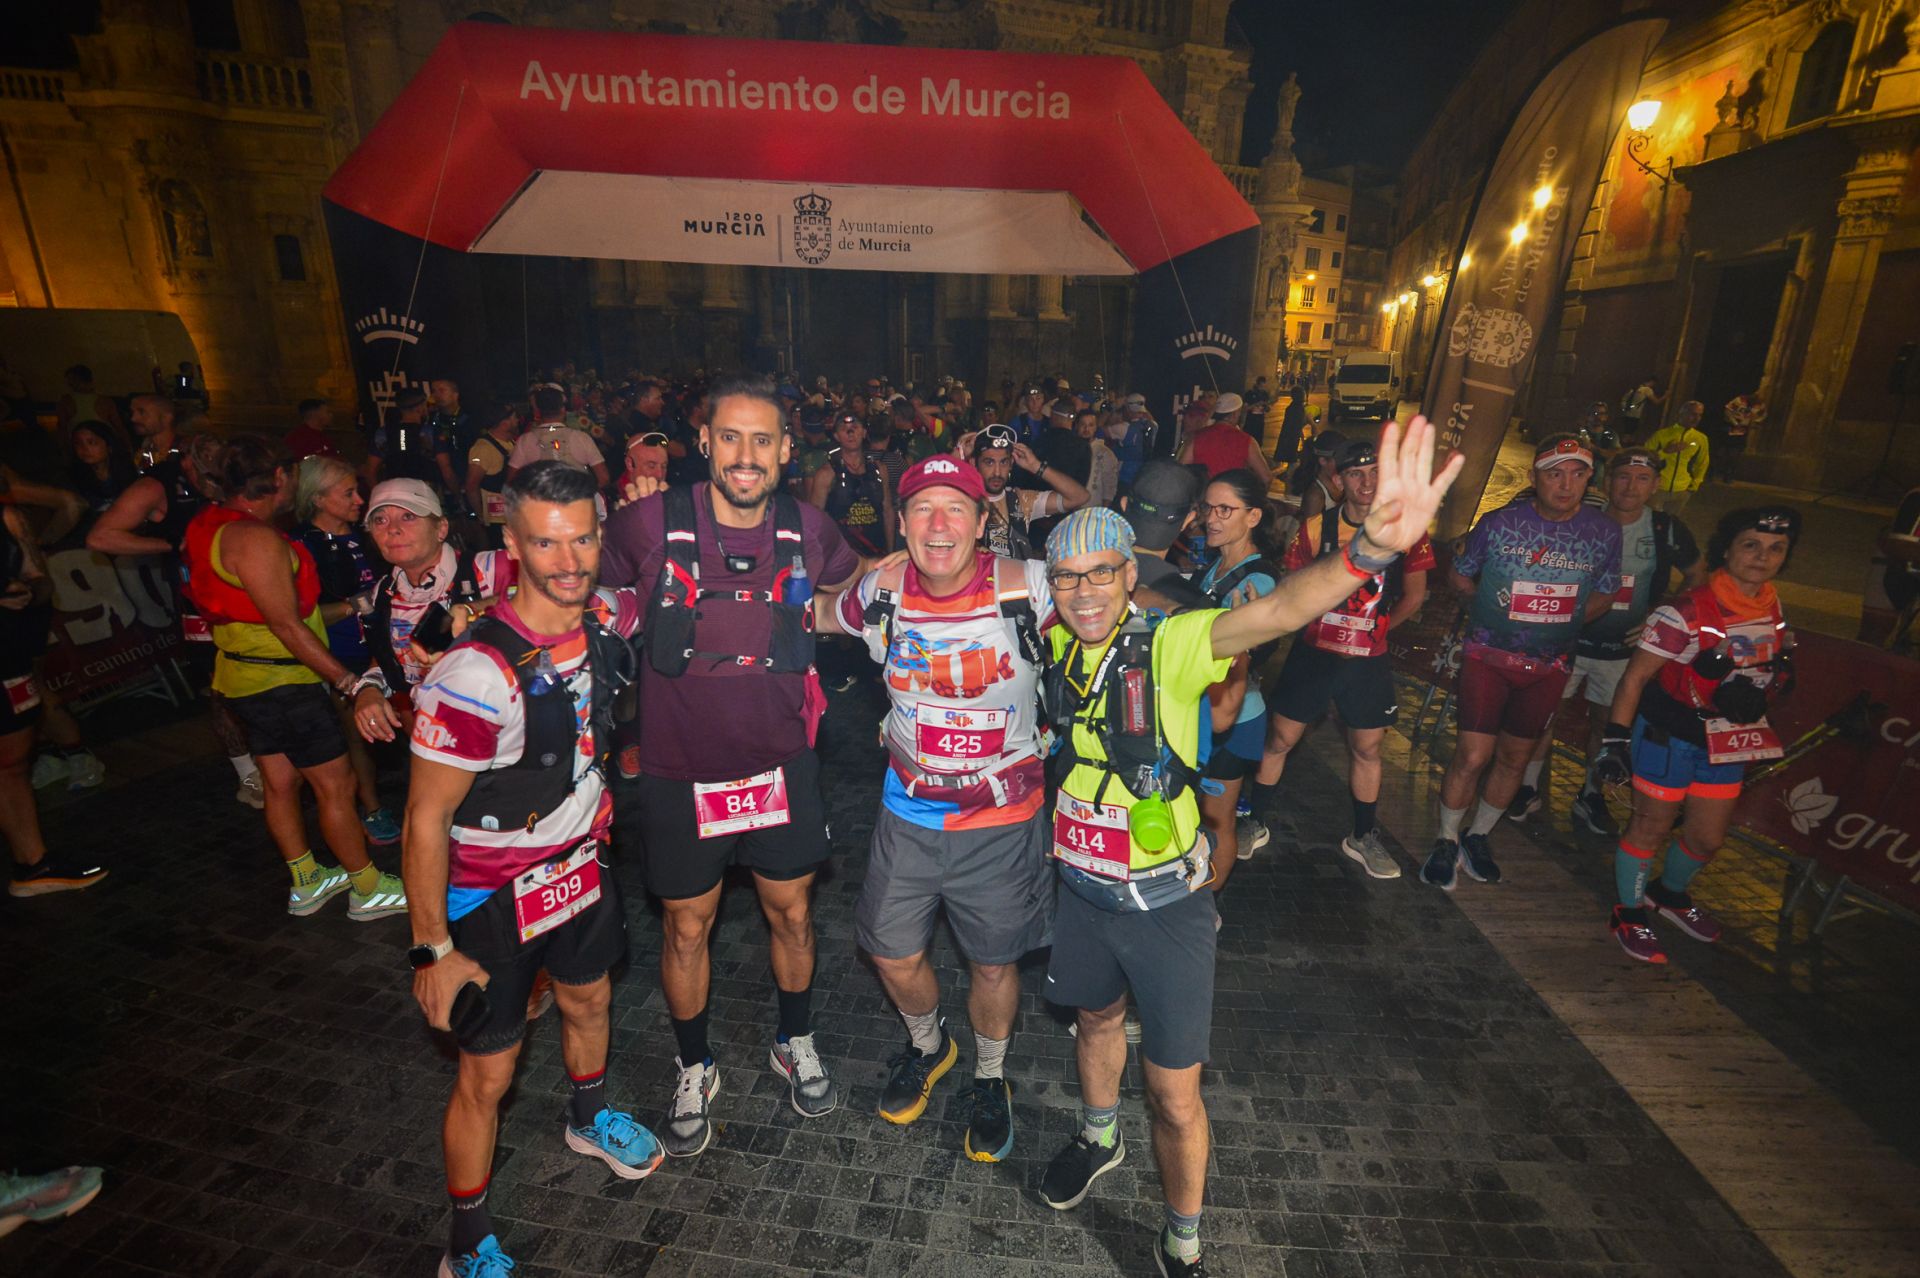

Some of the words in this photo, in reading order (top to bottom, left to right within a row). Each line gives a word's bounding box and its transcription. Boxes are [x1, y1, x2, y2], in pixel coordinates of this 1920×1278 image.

[520, 60, 839, 112] Ayuntamiento
[852, 75, 906, 115] de
[920, 77, 1071, 120] Murcia
[725, 211, 764, 223] 1200
[683, 219, 767, 237] MURCIA
[838, 217, 935, 237] Ayuntamiento
[838, 237, 855, 251] de
[858, 237, 912, 253] Murcia
[1515, 276, 1534, 303] de
[1528, 187, 1570, 273] Murcia
[1527, 598, 1560, 612] 429
[1336, 629, 1357, 643] 37
[82, 641, 154, 678] camino
[157, 631, 177, 650] de
[938, 734, 982, 753] 425
[1728, 732, 1763, 748] 479
[726, 792, 756, 814] 84
[1067, 825, 1105, 853] 414
[541, 874, 582, 911] 309
